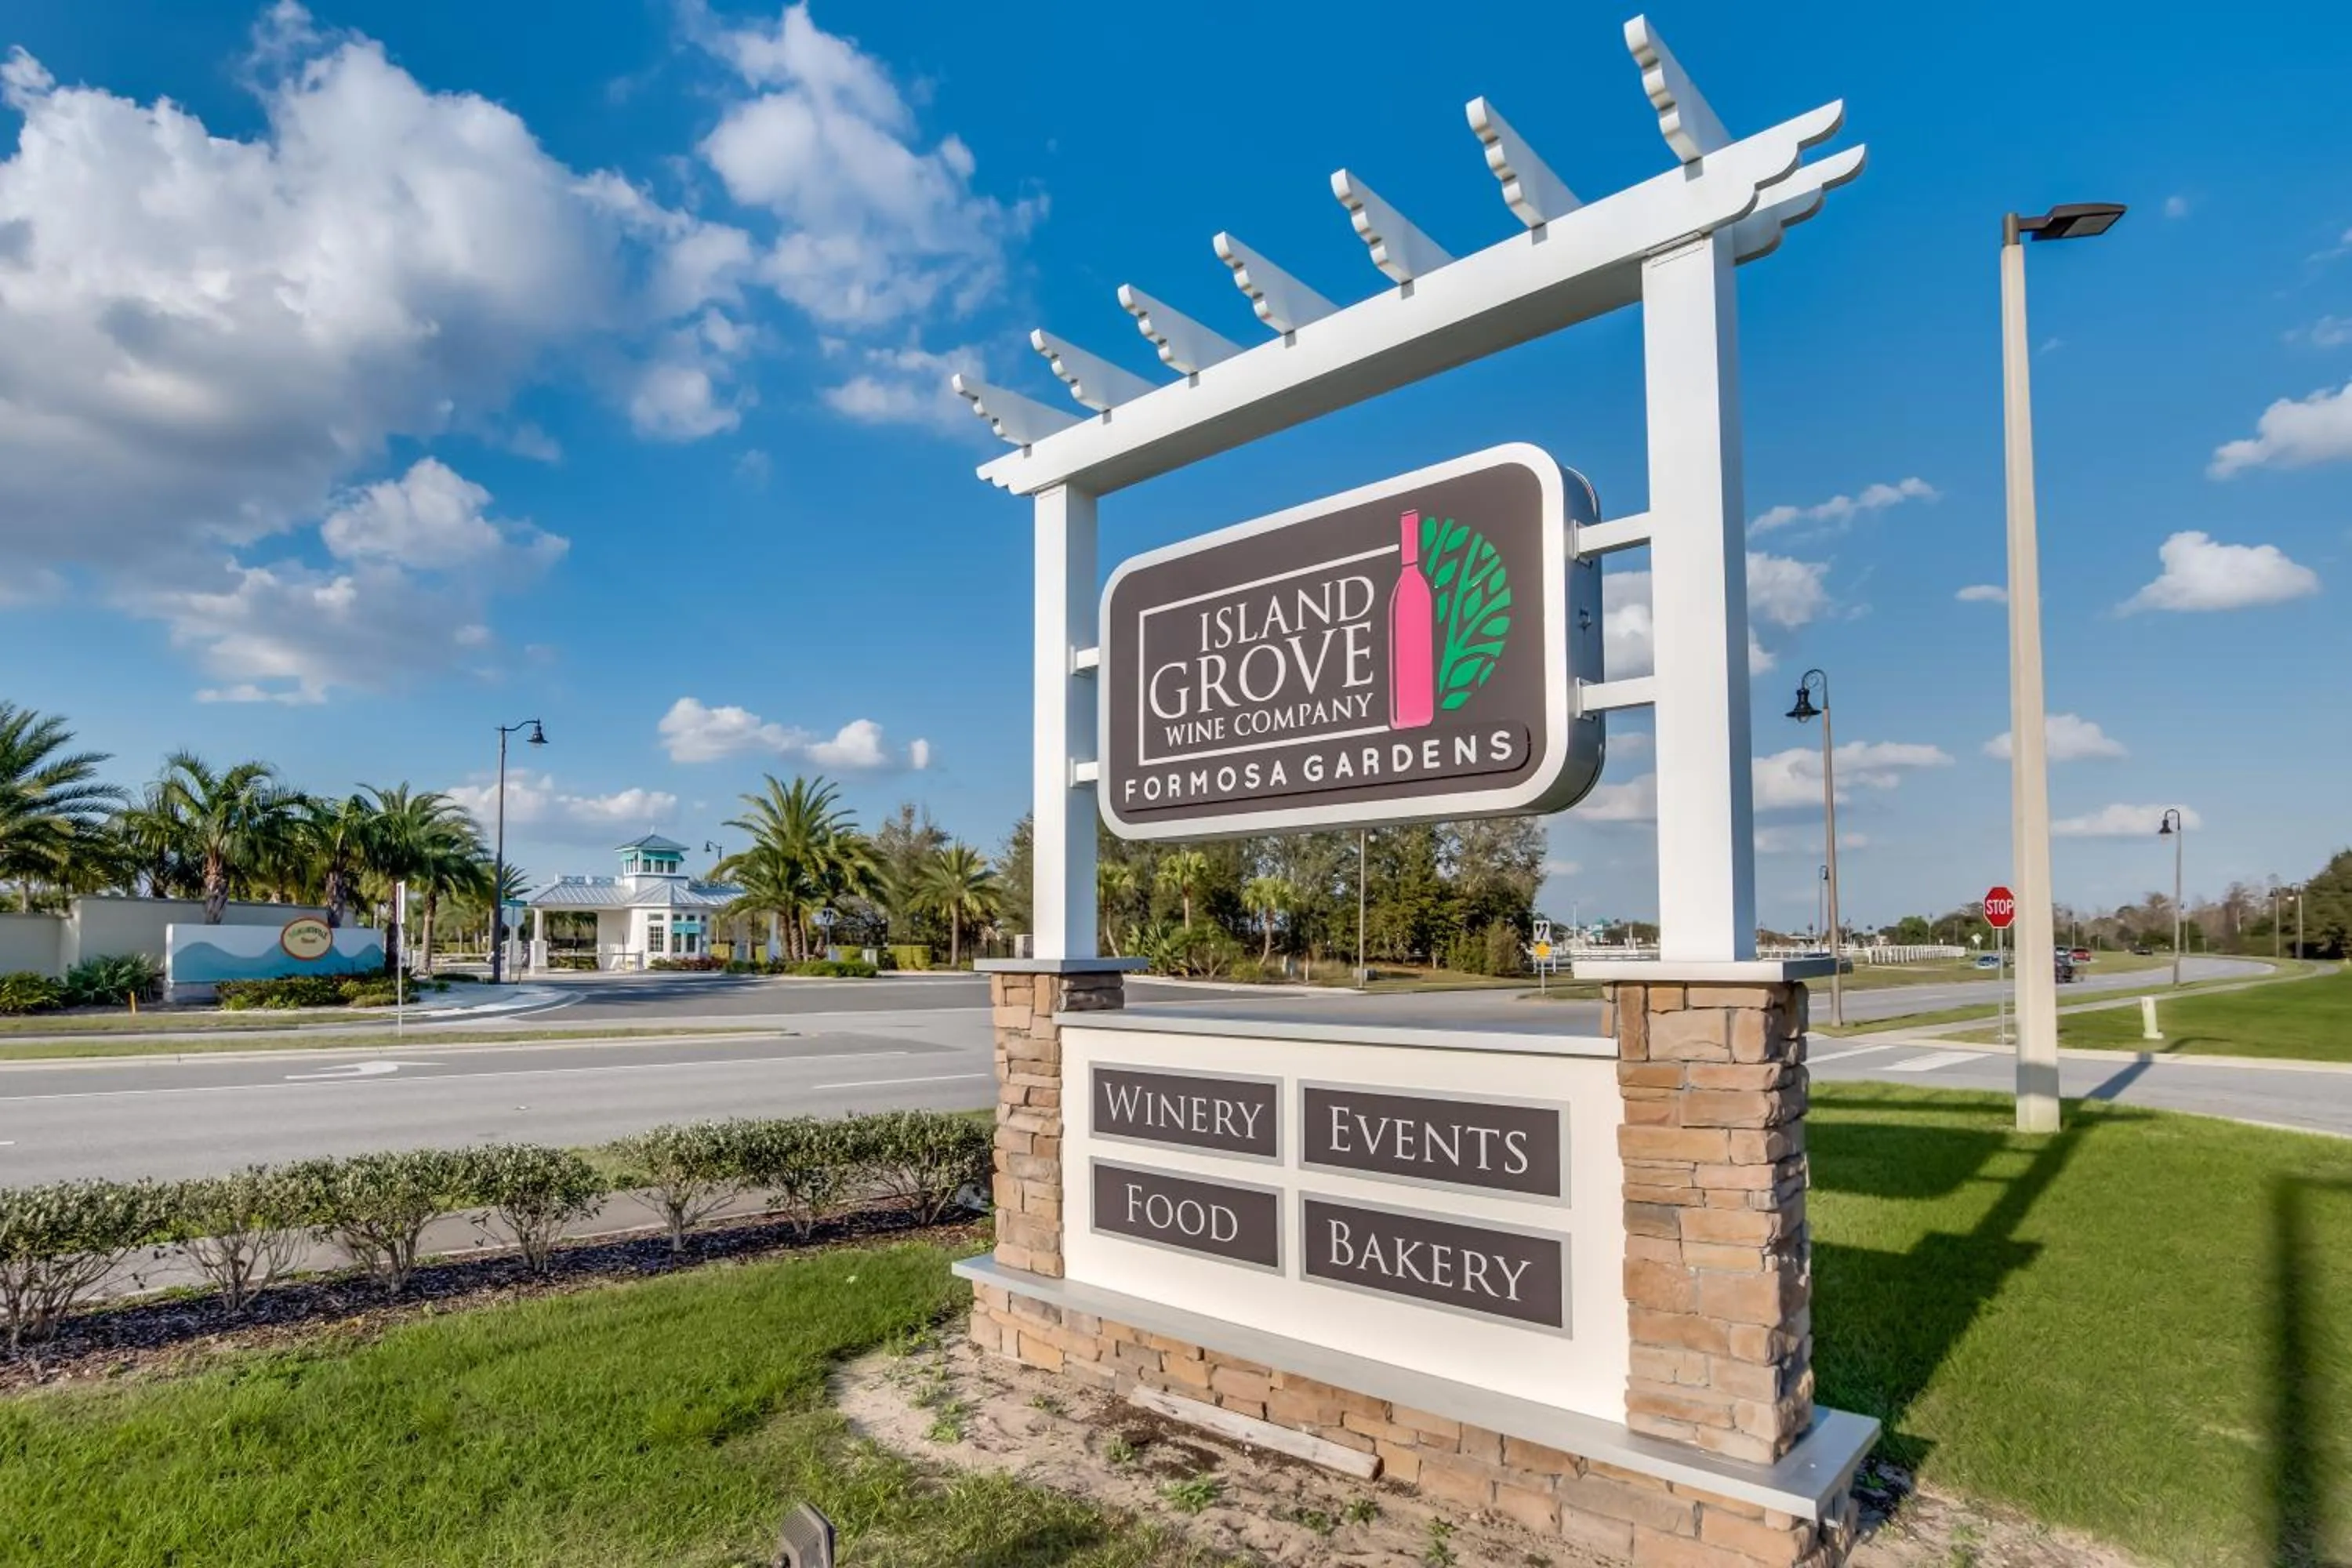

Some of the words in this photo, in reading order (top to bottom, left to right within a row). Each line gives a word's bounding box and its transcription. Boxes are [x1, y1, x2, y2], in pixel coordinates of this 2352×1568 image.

[1199, 575, 1374, 652] ISLAND
[1149, 622, 1374, 720] GROVE
[1165, 717, 1225, 747] WINE
[1234, 692, 1374, 736] COMPANY
[1125, 760, 1287, 804] FORMOSA
[1303, 730, 1513, 782] GARDENS
[1986, 899, 2014, 915] STOP
[1104, 1082, 1265, 1140] WINERY
[1329, 1105, 1529, 1174] EVENTS
[1124, 1183, 1239, 1242] FOOD
[1327, 1219, 1532, 1301] BAKERY
